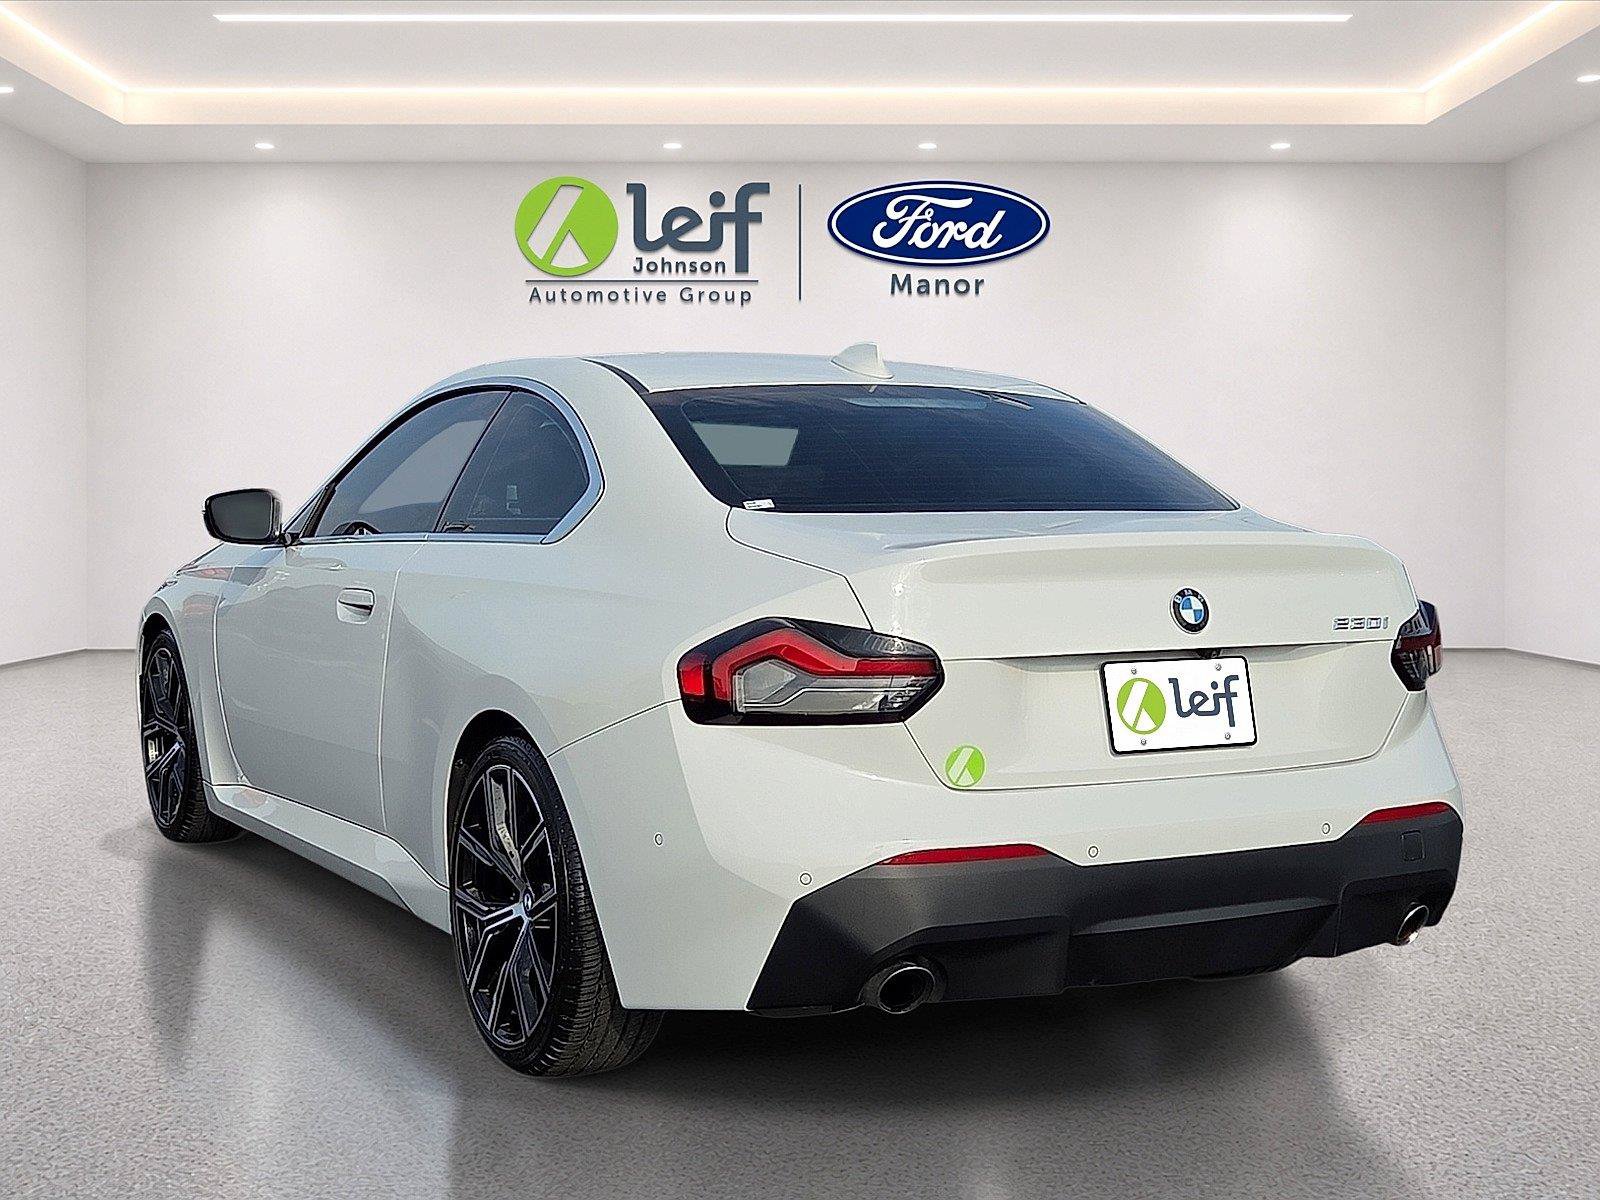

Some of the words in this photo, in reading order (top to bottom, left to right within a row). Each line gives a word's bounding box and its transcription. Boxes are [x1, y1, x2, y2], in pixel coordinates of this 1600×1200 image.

[872, 194, 1006, 249] Ford
[633, 256, 726, 274] Johnson
[890, 273, 986, 296] Manor
[528, 285, 667, 303] Automotive
[679, 286, 752, 306] Group
[1332, 616, 1389, 630] 230i
